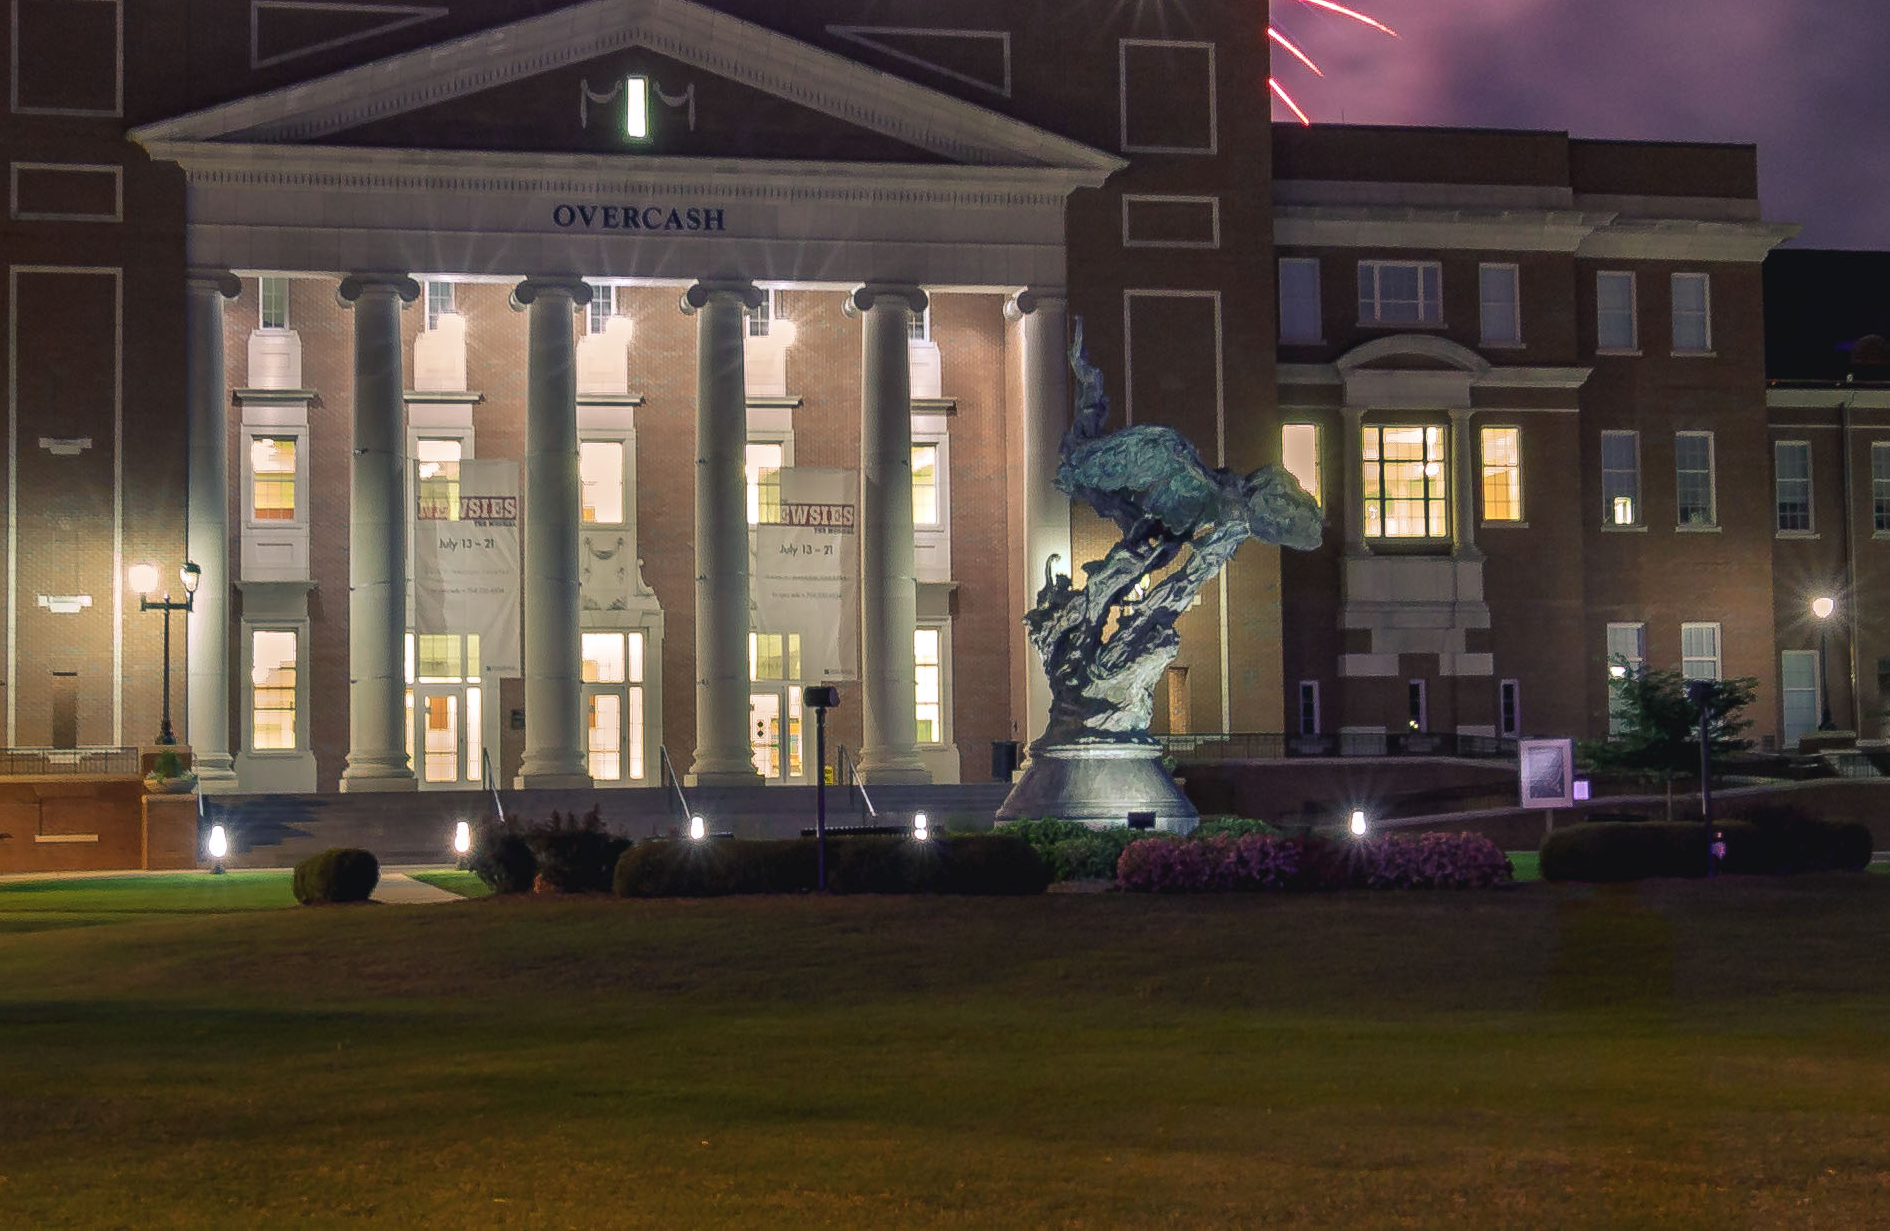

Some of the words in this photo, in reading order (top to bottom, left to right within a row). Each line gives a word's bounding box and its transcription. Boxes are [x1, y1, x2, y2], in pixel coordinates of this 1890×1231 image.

[553, 204, 726, 230] OVERCASH
[768, 504, 854, 526] EWSIES
[439, 537, 458, 552] July
[461, 538, 473, 549] 13
[483, 538, 495, 549] 21
[779, 543, 799, 557] July
[802, 544, 813, 555] 13
[823, 544, 834, 556] 21
